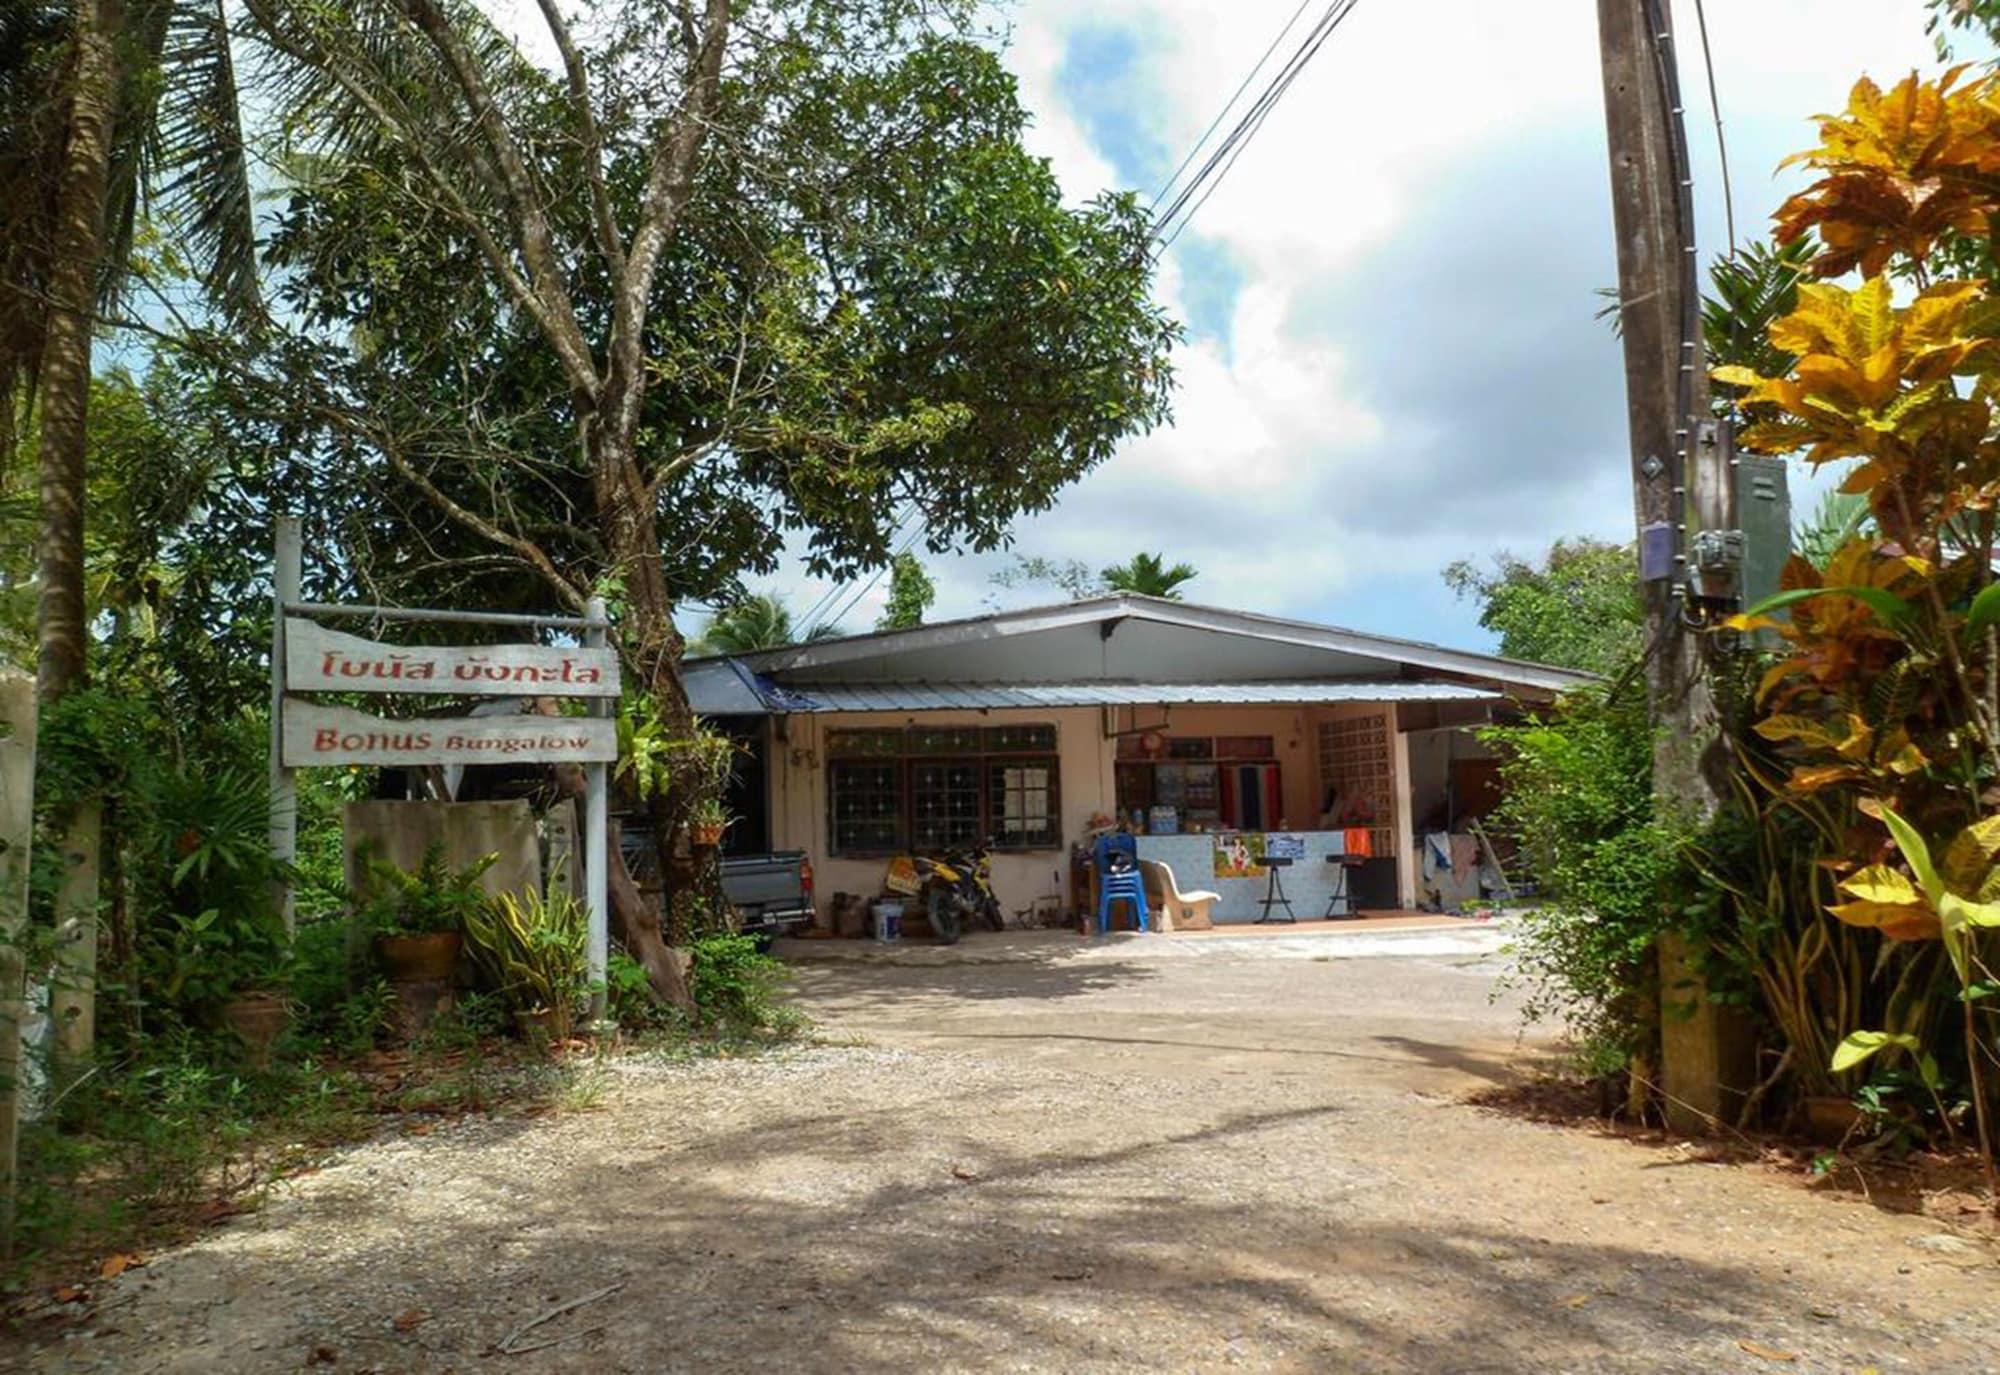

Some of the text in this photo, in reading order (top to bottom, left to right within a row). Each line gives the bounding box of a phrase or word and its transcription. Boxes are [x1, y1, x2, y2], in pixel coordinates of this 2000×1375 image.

[322, 651, 600, 683] โบนัส บังกะโล
[314, 729, 592, 753] Bonus Bungalow
